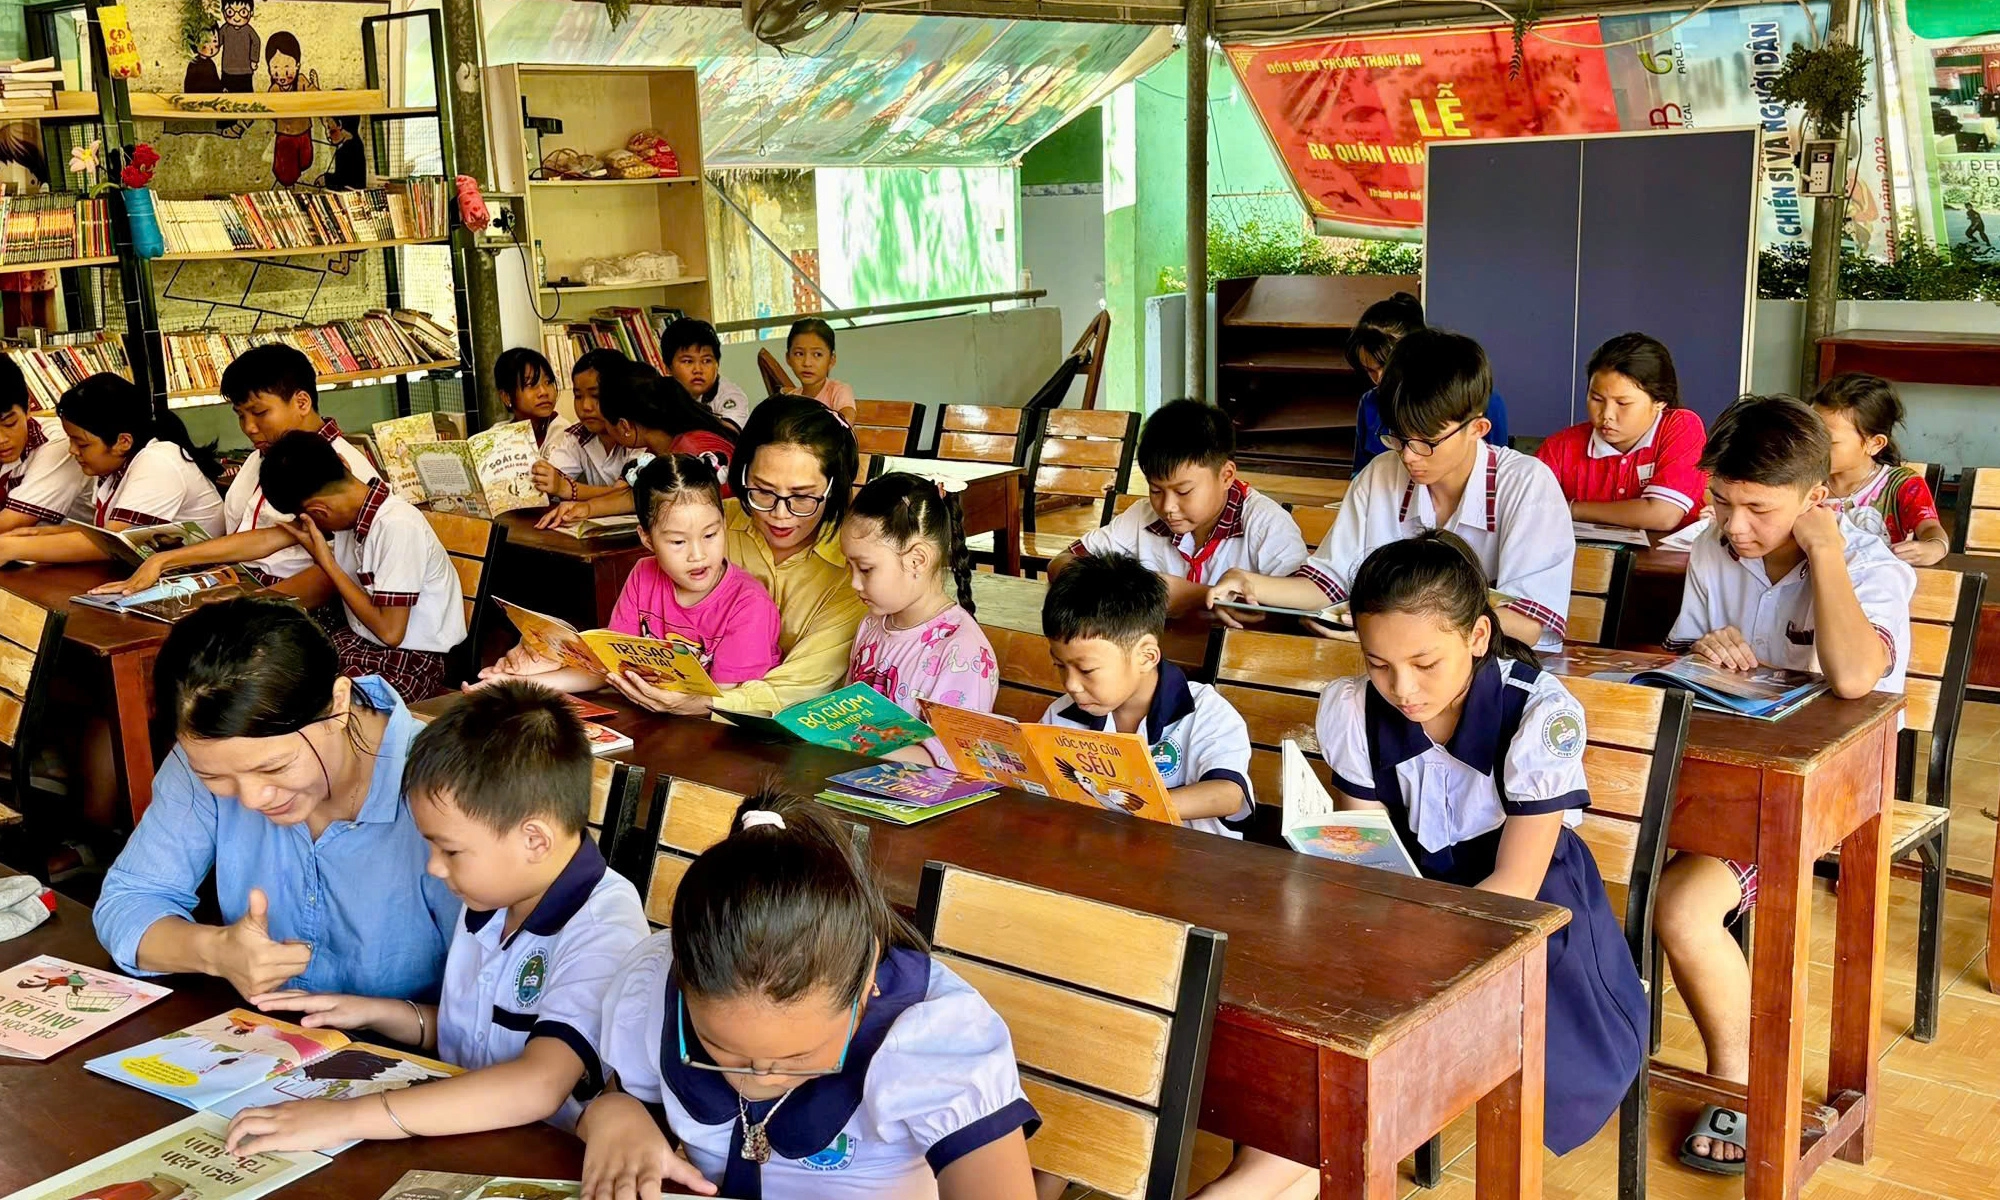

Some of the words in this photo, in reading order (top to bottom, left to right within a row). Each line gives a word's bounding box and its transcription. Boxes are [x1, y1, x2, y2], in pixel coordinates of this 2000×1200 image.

[1744, 22, 1780, 66] DÂN
[1361, 54, 1401, 70] THẠNH
[1404, 53, 1422, 66] AN
[1409, 82, 1472, 137] LỄ
[1683, 102, 1695, 130] DICAL
[1307, 141, 1334, 160] RA
[1334, 141, 1386, 164] QUÂN
[1386, 139, 1425, 165] HUẤ
[1763, 187, 1803, 236] CHIẾN
[30, 1009, 85, 1029] ANH
[1709, 1107, 1738, 1136] C
